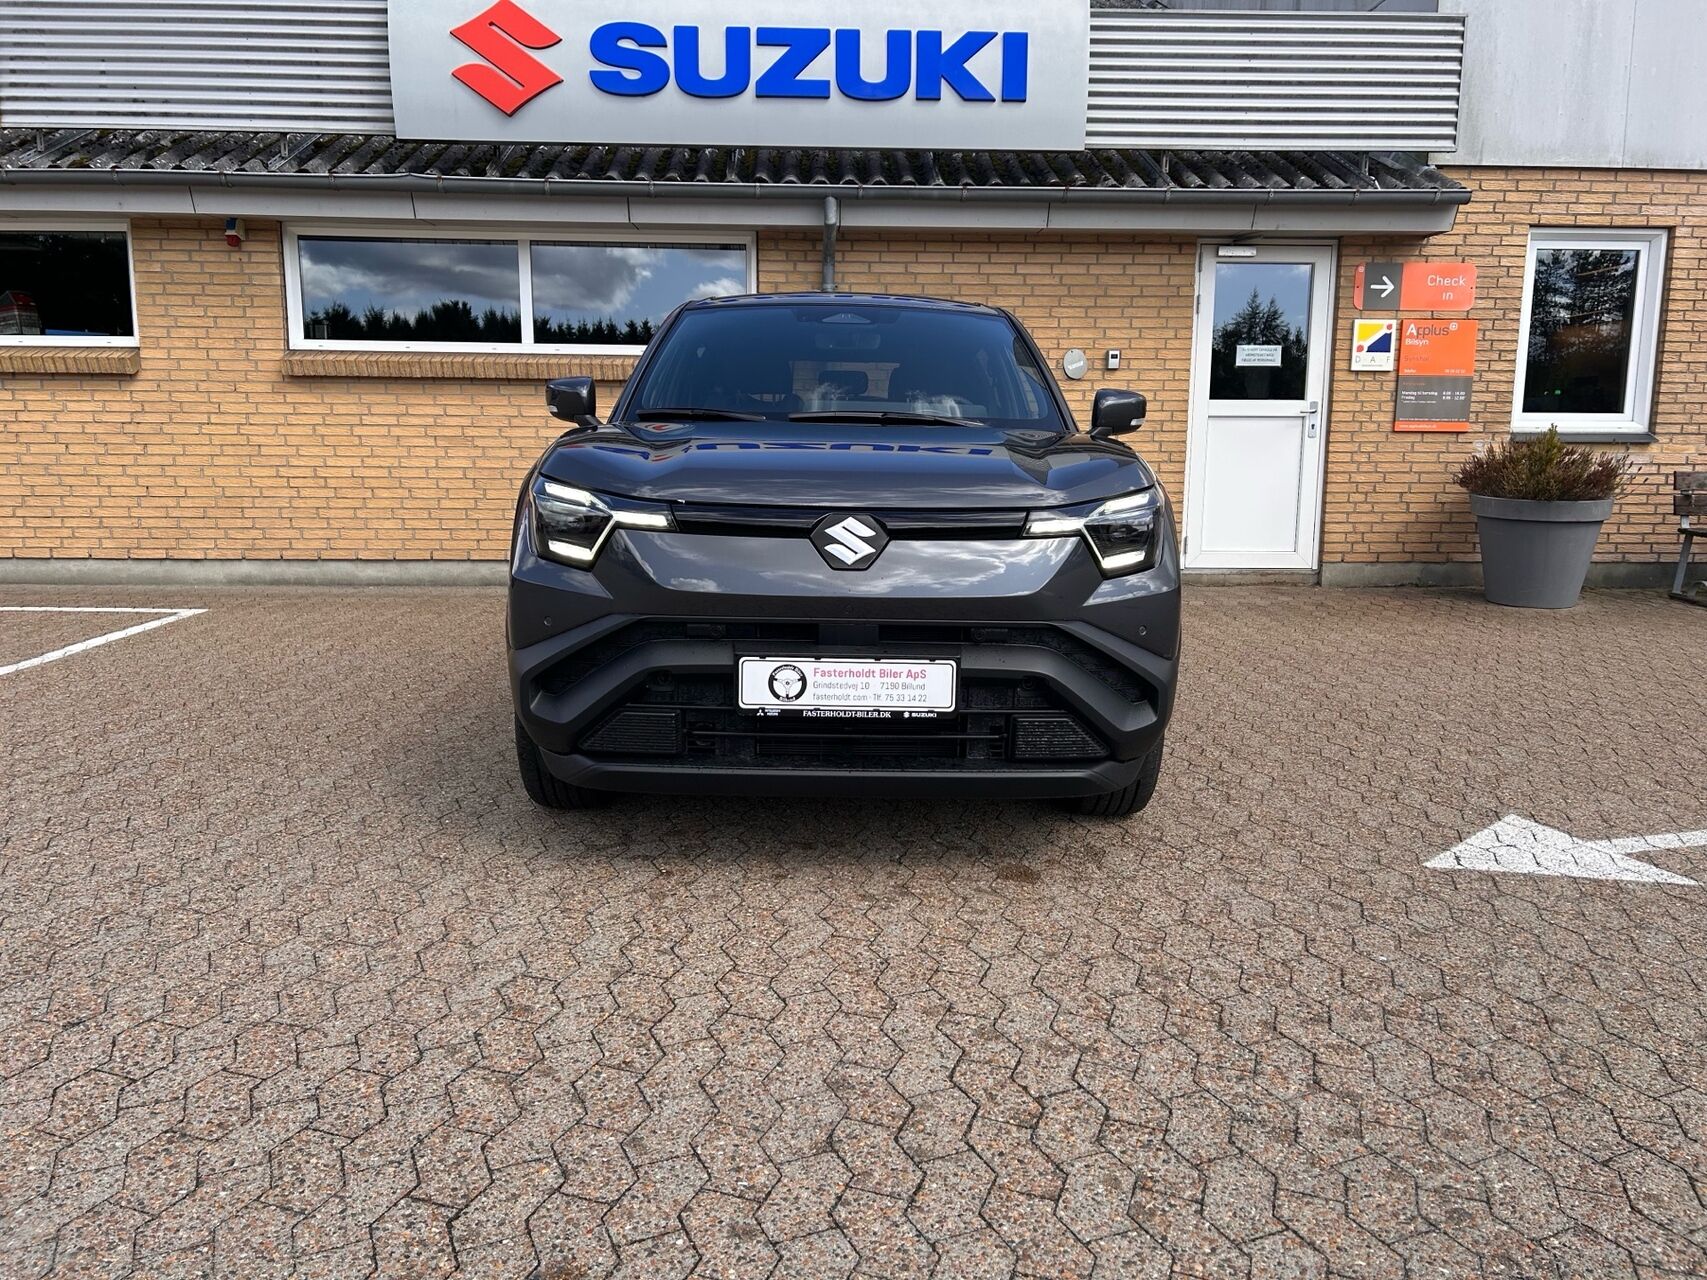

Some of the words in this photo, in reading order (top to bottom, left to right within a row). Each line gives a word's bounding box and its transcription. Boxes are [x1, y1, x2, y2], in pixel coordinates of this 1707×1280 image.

[588, 22, 1028, 103] SUZUKI
[1427, 274, 1466, 287] Check
[1442, 291, 1453, 301] in
[1405, 338, 1429, 347] Bilsyn
[813, 667, 876, 678] Fasterholdt
[879, 668, 903, 679] Biler
[906, 669, 927, 681] ApS
[812, 681, 859, 691] Grindstedvej
[860, 682, 870, 690] 10
[880, 682, 899, 690] 7190
[885, 694, 895, 702] 75
[896, 694, 905, 702] 33
[907, 694, 918, 702] 14
[918, 694, 927, 702] 22
